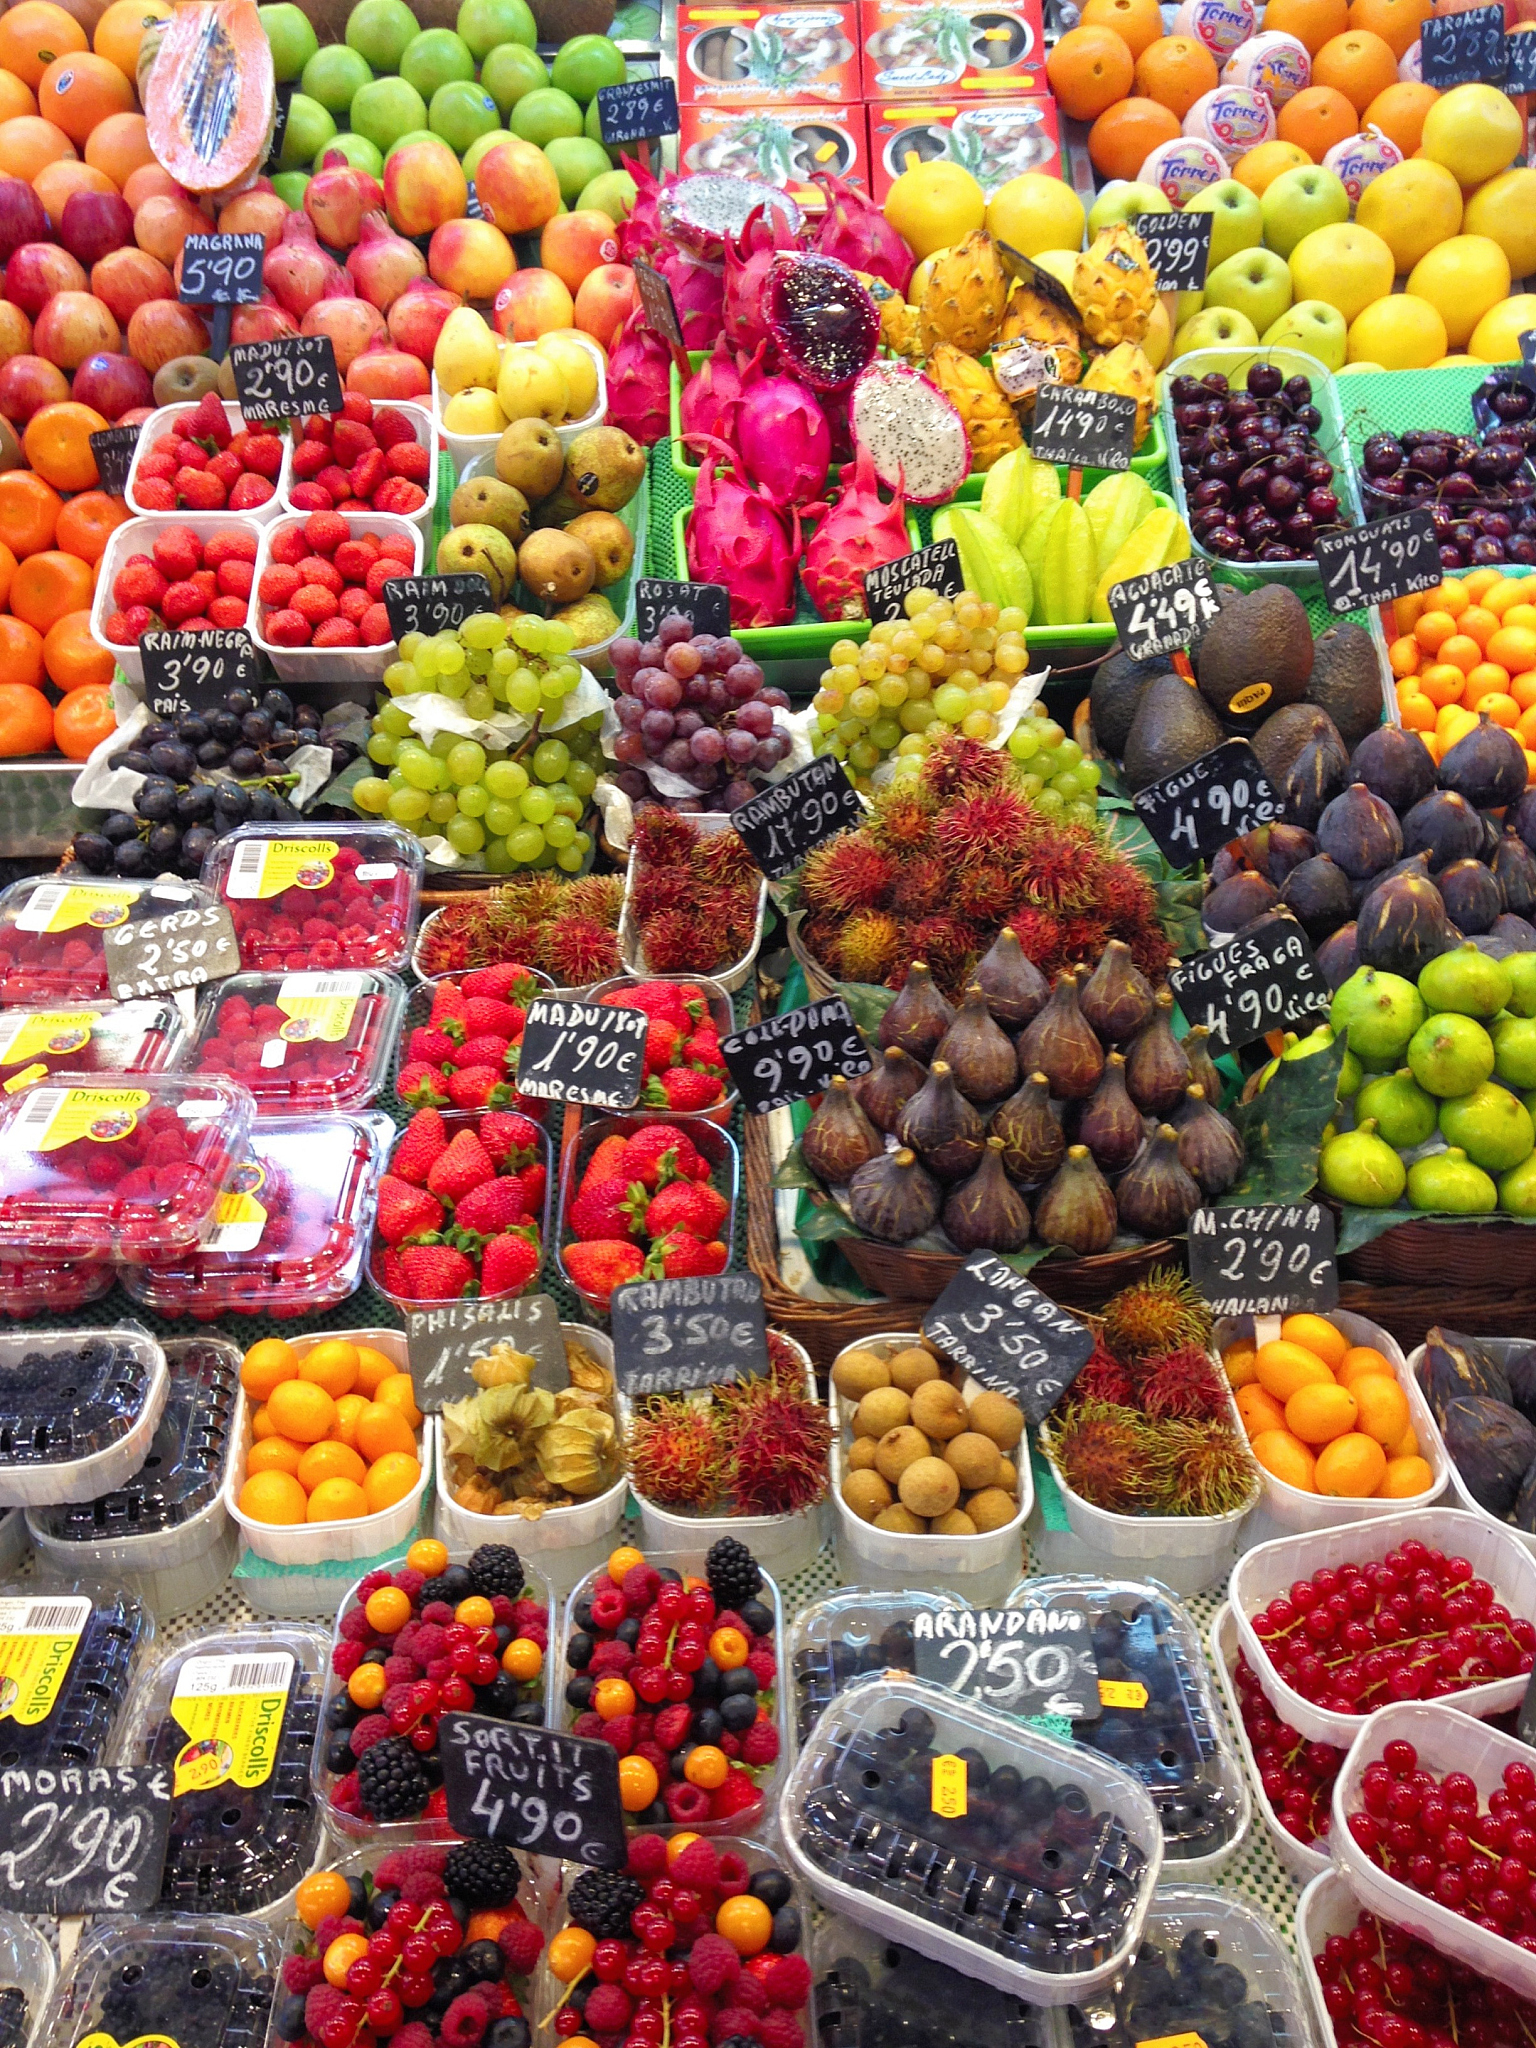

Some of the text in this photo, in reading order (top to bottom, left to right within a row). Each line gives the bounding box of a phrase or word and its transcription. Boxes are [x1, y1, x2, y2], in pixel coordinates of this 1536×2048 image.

[1212, 100, 1268, 124] Torres
[1162, 158, 1220, 183] Torres
[185, 233, 264, 251] MAGRANA
[1136, 213, 1204, 237] GOLDEN
[180, 255, 256, 294] 5'90
[244, 357, 314, 398] 2'90
[243, 398, 331, 421] MARESME
[1034, 404, 1109, 439] 14'90
[866, 542, 956, 593] MOSCATELL
[872, 563, 945, 603] TEULADA
[640, 580, 709, 601] ROSAT
[158, 652, 247, 691] 3'90 €
[732, 756, 838, 832] RAMBUTAN
[114, 906, 221, 946] GERDS
[137, 937, 232, 976] 2'50 €
[1171, 939, 1260, 992] FIGUES
[1222, 935, 1304, 988] FRAGA
[117, 966, 208, 999] EXTRA
[1206, 983, 1283, 1045] 4'90
[531, 1030, 637, 1073] 1'90 €
[753, 1035, 867, 1093] 9'90 €
[519, 1078, 623, 1108] MARESME
[1219, 1237, 1332, 1285] 2'90 €
[411, 1299, 544, 1339] PHISALIS
[641, 1313, 756, 1355] 3'50 €
[960, 1303, 1049, 1370] 3'50
[245, 1698, 282, 1779] Driscoll's
[464, 1749, 594, 1802] FRUITS
[470, 1778, 584, 1846] 4'90
[0, 1801, 142, 1891] 2'90
